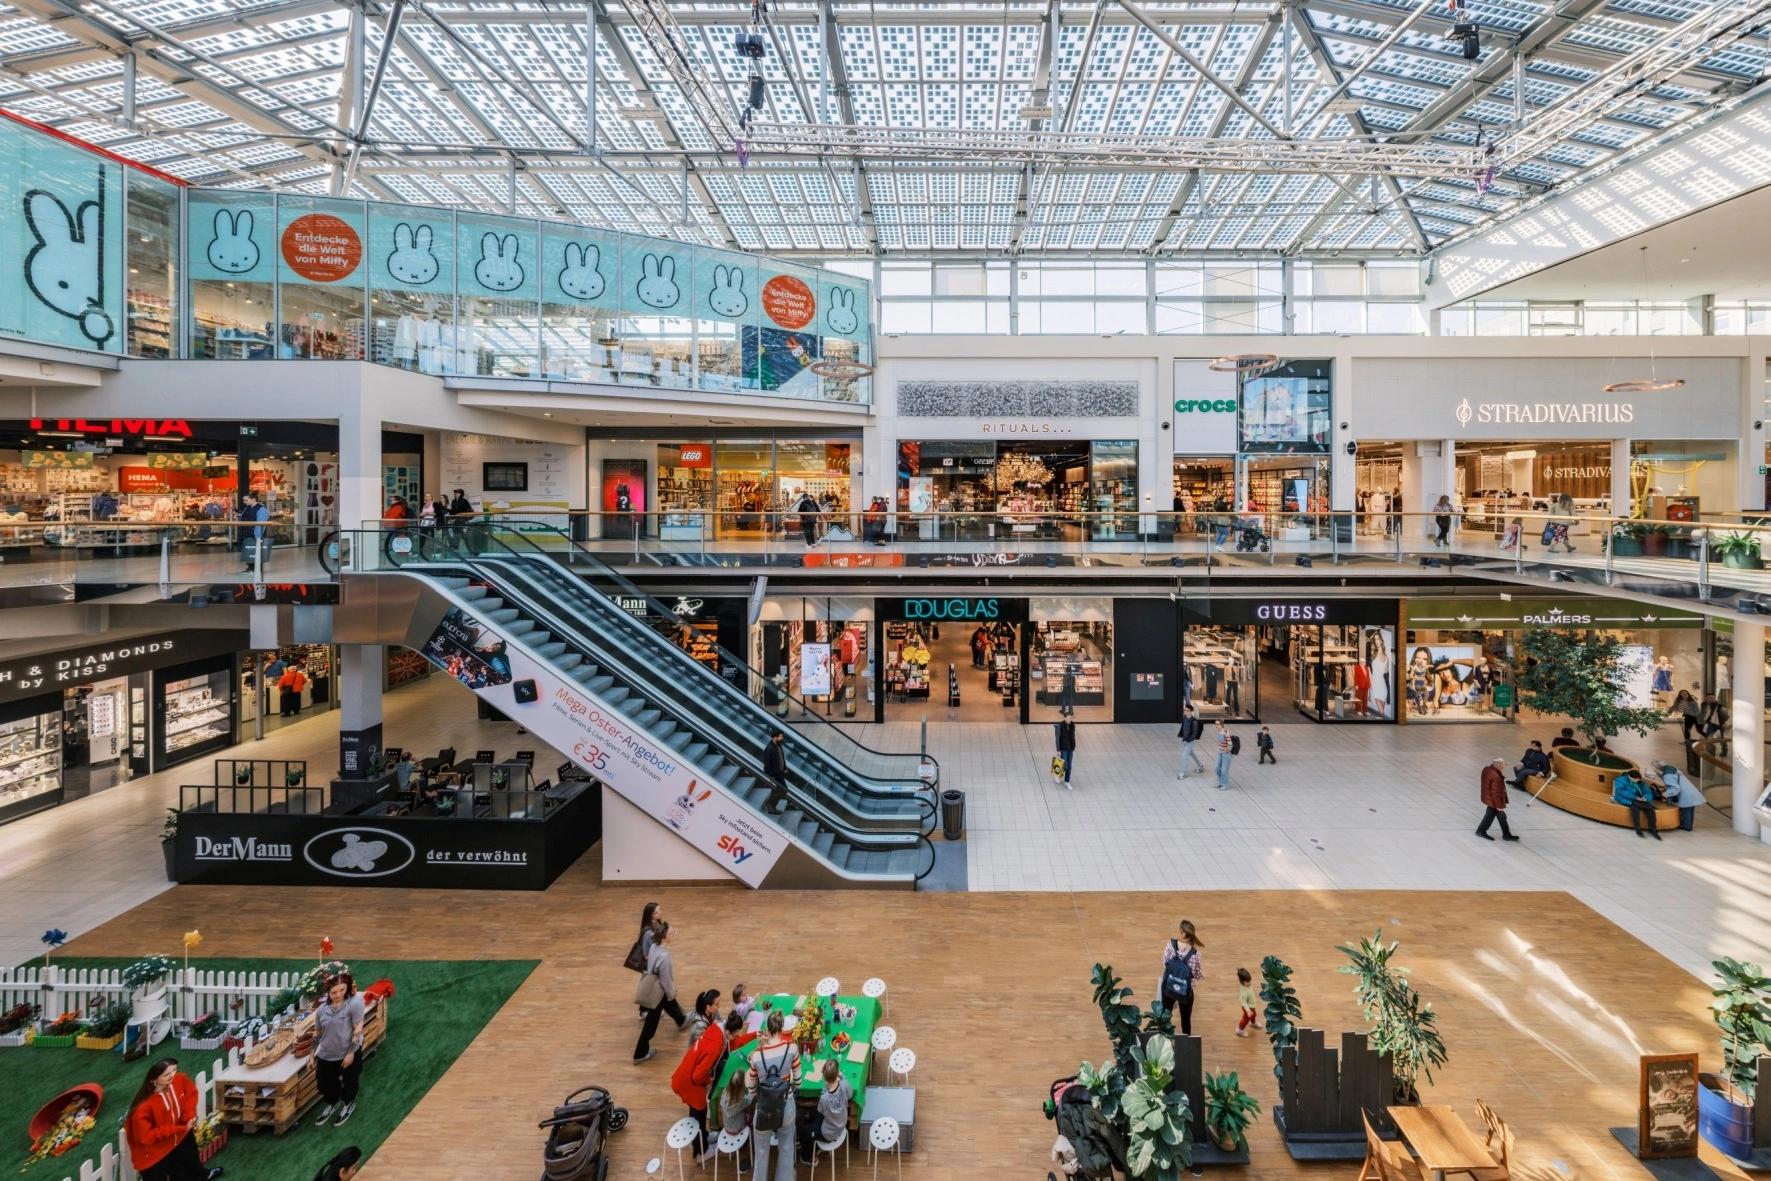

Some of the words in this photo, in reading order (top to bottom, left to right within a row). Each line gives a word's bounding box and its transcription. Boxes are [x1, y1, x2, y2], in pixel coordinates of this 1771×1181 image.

[295, 233, 349, 245] Entdecke
[299, 244, 317, 253] die
[320, 245, 345, 255] Welt
[320, 256, 349, 267] Miffy
[771, 289, 807, 301] Entdecke
[788, 300, 805, 309] Welt
[788, 308, 808, 318] Miffy
[1175, 399, 1237, 413] crocs
[1478, 403, 1633, 423] STRADIVARIUS
[982, 423, 1071, 433] RITUALS...
[682, 451, 701, 460] LEGO
[904, 599, 999, 619] DOUGLAS
[1257, 605, 1325, 619] GUESS
[1523, 615, 1591, 624] PALMERS
[442, 620, 469, 642] euphoria
[29, 665, 42, 676] &
[58, 640, 173, 671] DIAMONDS
[20, 678, 43, 689] by
[58, 663, 107, 682] KISS
[555, 687, 587, 715] Mega
[588, 710, 676, 777] Oster-Angebot!
[568, 713, 587, 730] Serien
[591, 730, 620, 753] Live-Sport
[620, 750, 630, 761] mit
[631, 757, 641, 769] Sky
[582, 744, 611, 770] 35
[718, 813, 728, 824] Sky
[728, 821, 753, 841] Infostand
[735, 818, 750, 830] Jetzt
[749, 827, 763, 839] beim
[194, 836, 292, 860] DerMann
[426, 849, 451, 861] der
[457, 849, 528, 862] verwöhnt
[716, 834, 754, 865] sky
